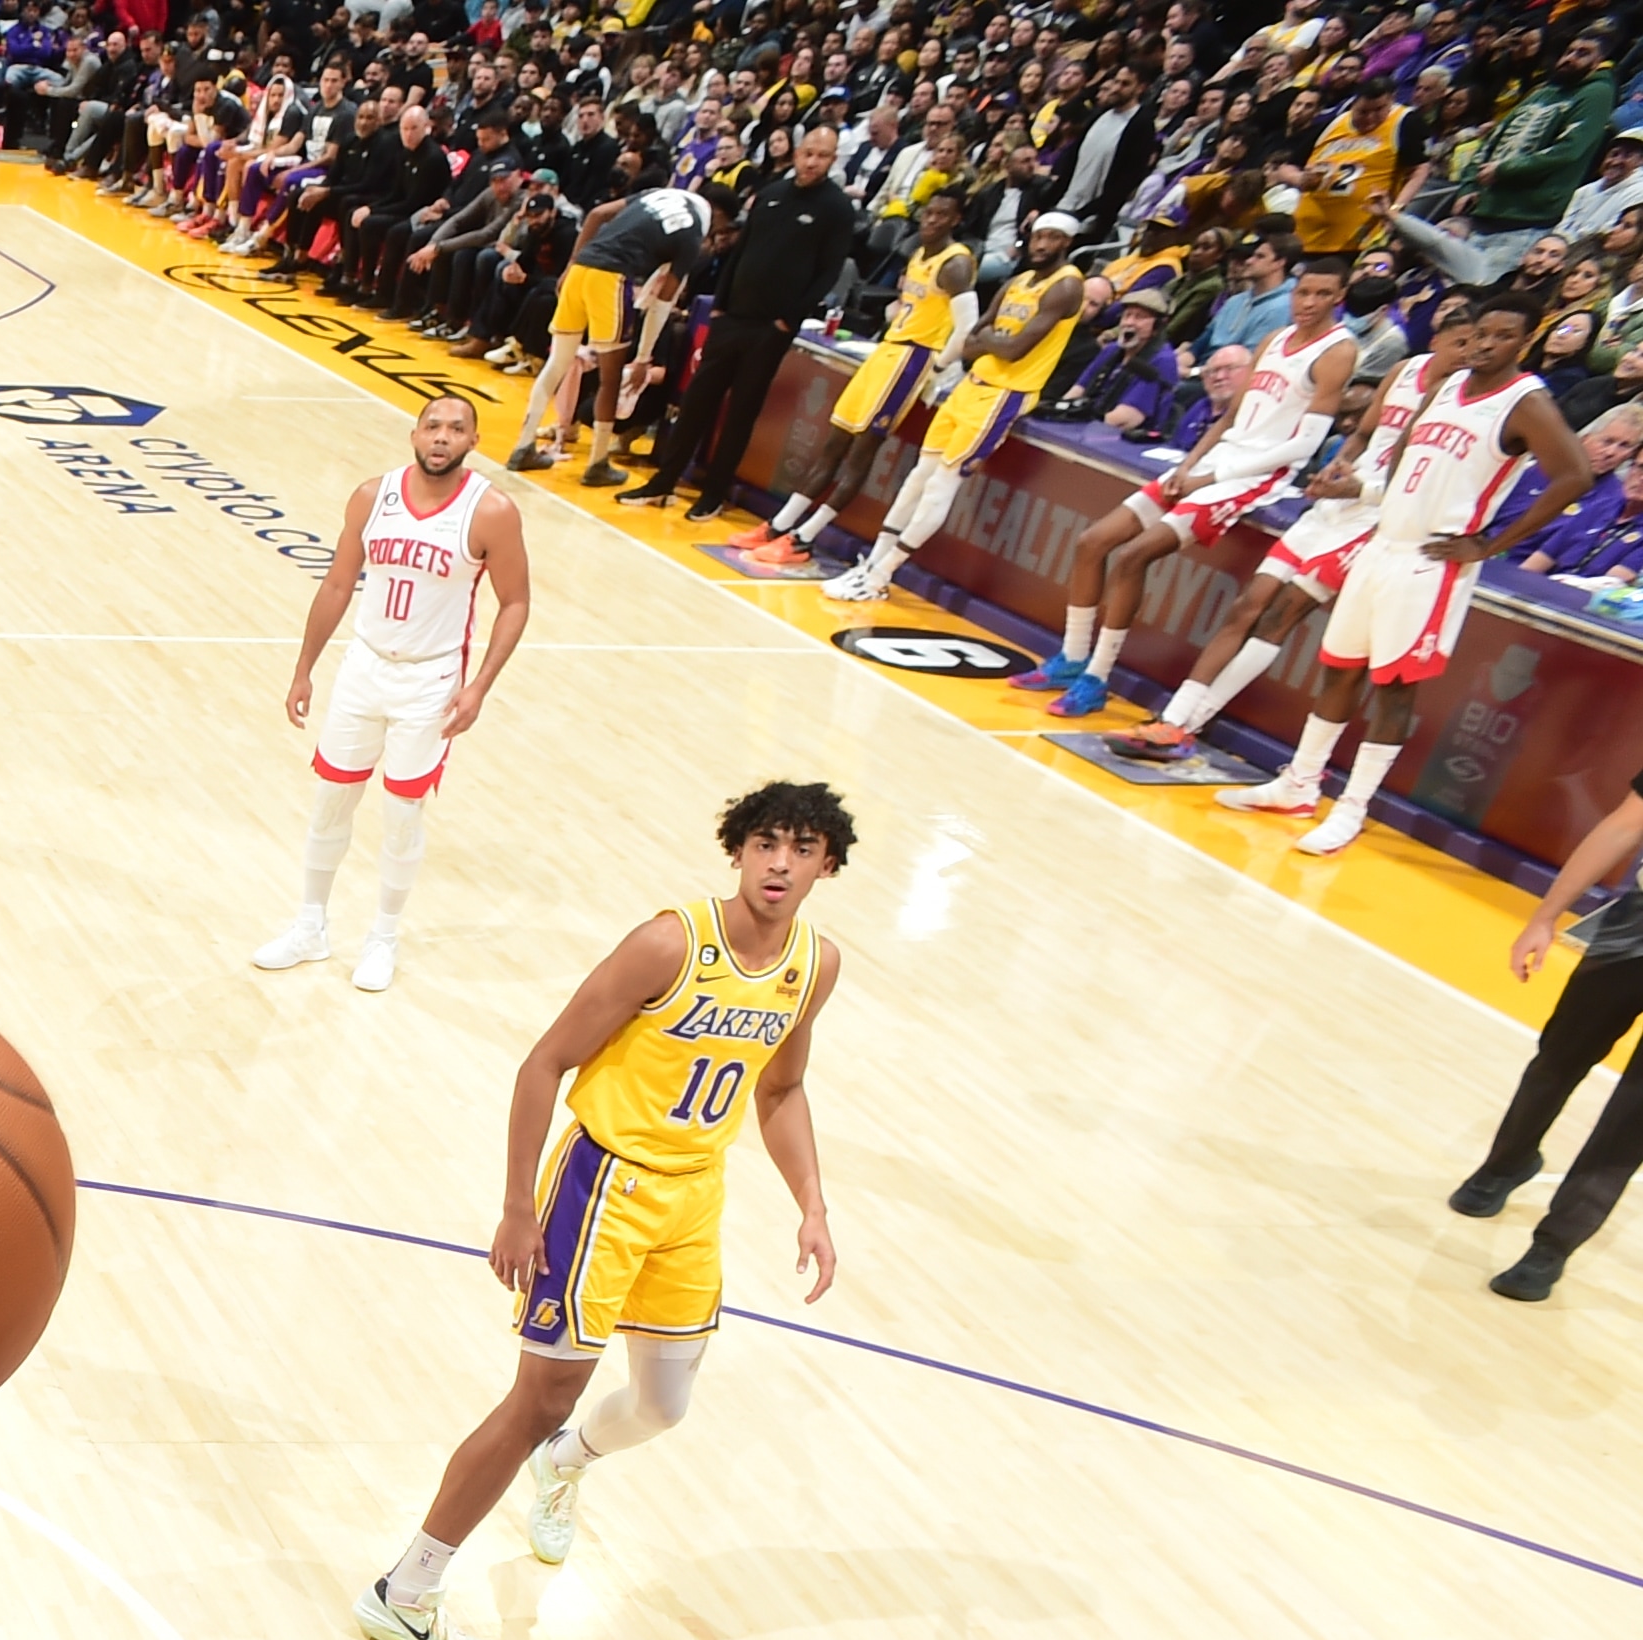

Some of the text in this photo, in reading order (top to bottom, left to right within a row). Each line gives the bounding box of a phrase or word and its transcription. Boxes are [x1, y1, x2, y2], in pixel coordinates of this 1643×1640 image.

[241, 297, 504, 404] LEXUS
[25, 436, 178, 515] ARENA
[1403, 456, 1431, 494] 8
[368, 537, 454, 578] ROCKETS
[384, 576, 415, 622] 10
[855, 637, 1011, 669] 6
[701, 947, 717, 965] 6
[661, 994, 793, 1047] LAKERS
[666, 1055, 746, 1129] 10
